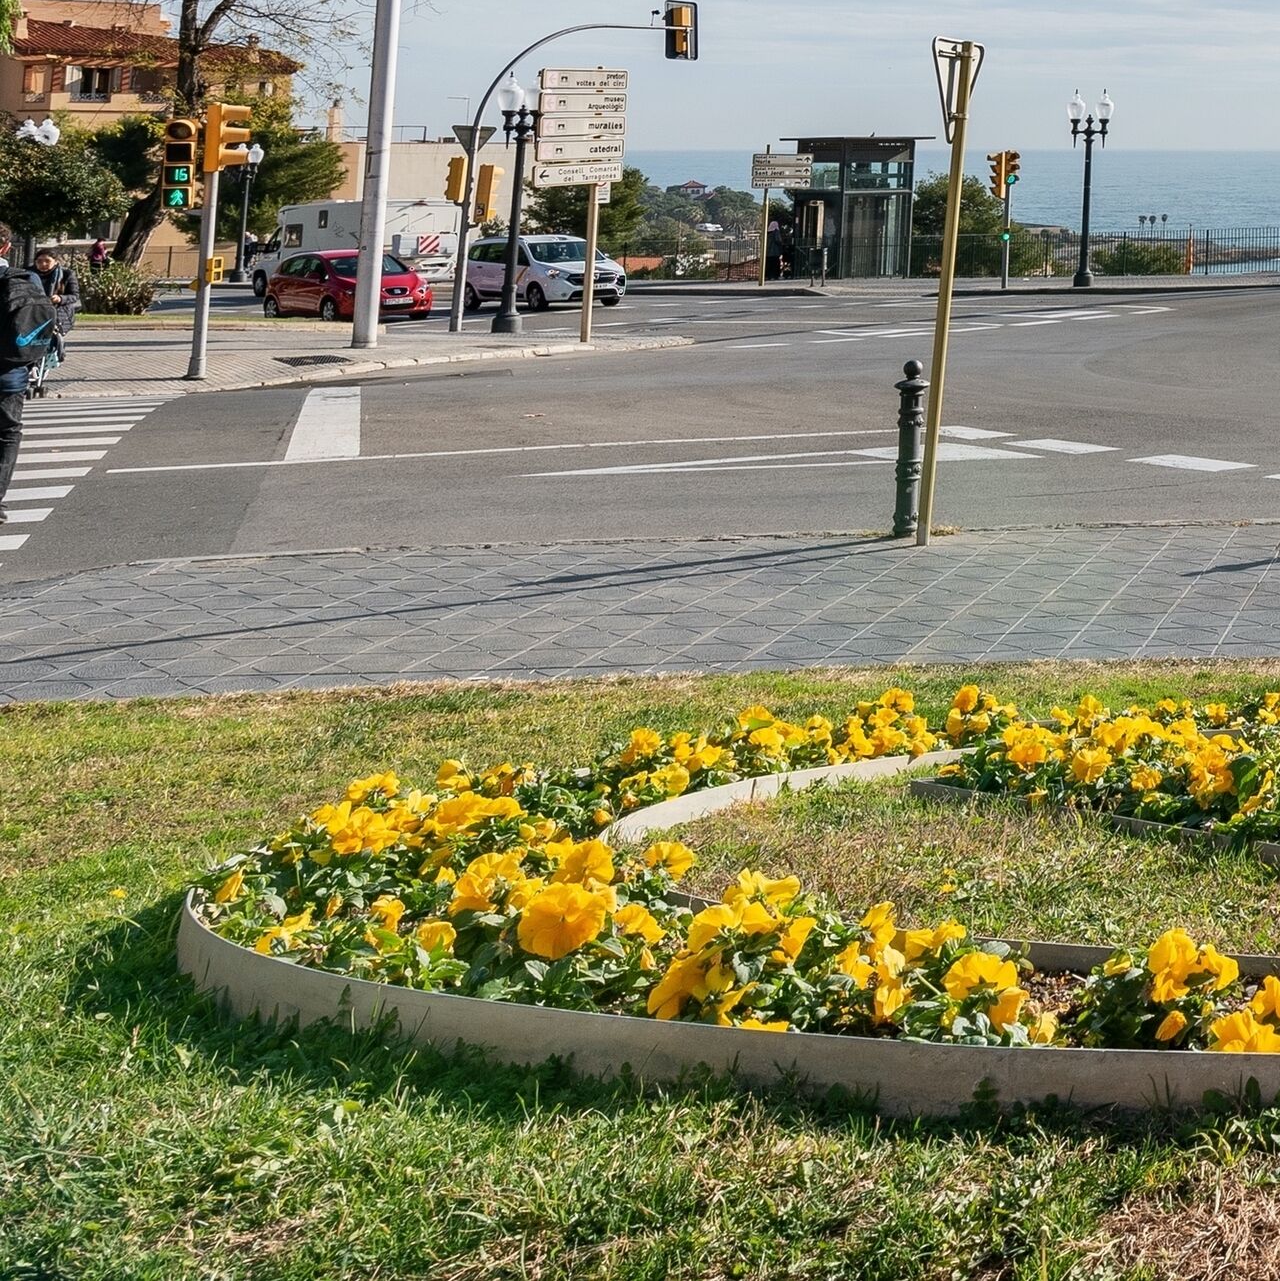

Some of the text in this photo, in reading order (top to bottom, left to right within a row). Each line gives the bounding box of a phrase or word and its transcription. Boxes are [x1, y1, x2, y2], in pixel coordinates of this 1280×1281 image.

[588, 122, 622, 130] muralles
[589, 144, 621, 153] catedral
[558, 165, 619, 175] Consell Comarcal
